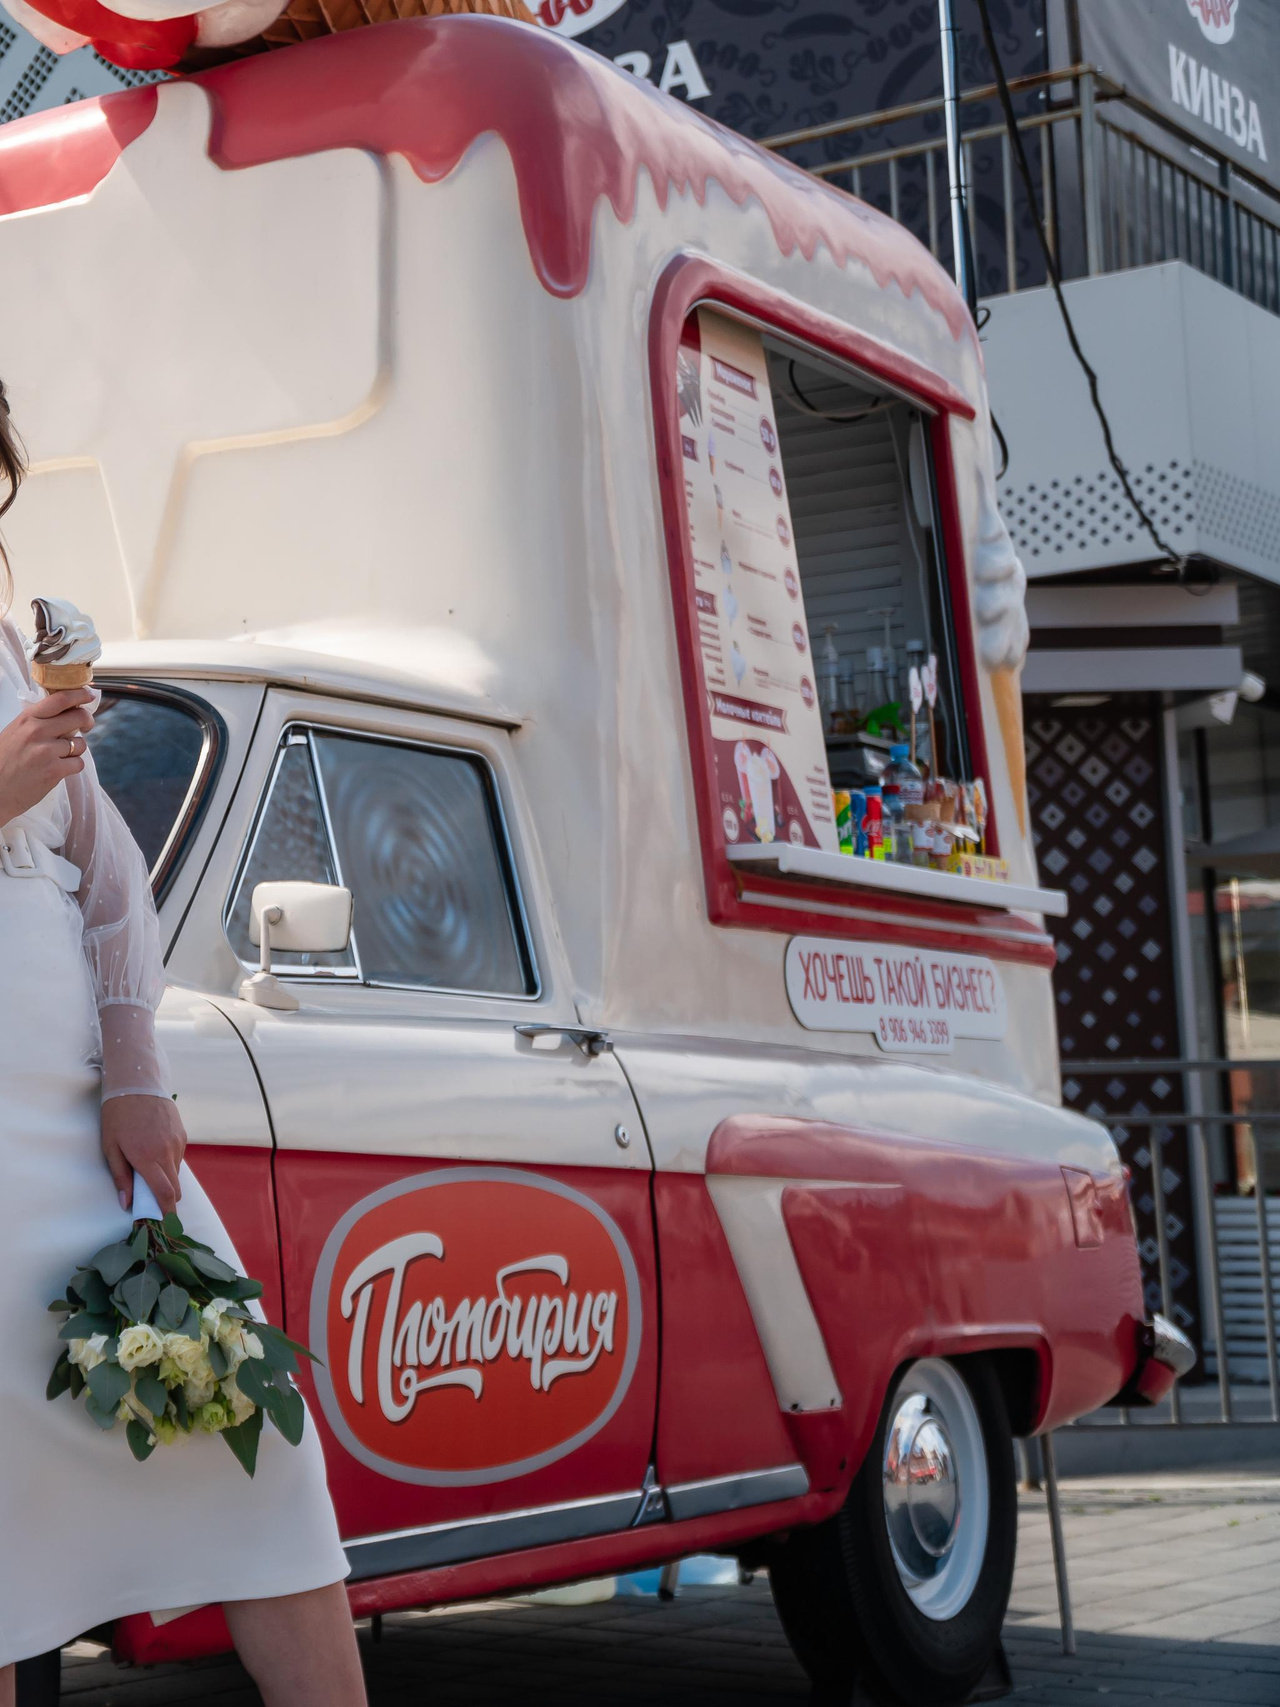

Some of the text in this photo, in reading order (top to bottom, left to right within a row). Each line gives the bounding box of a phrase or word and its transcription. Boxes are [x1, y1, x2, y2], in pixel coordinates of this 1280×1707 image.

[1168, 42, 1268, 162] КИНЗА
[799, 952, 997, 1014] ХОЧЕШЬ ТАКОЙ БИЗНЕС?
[879, 1018, 950, 1045] 8 906 946 3399
[341, 1231, 617, 1422] Пломбирия
